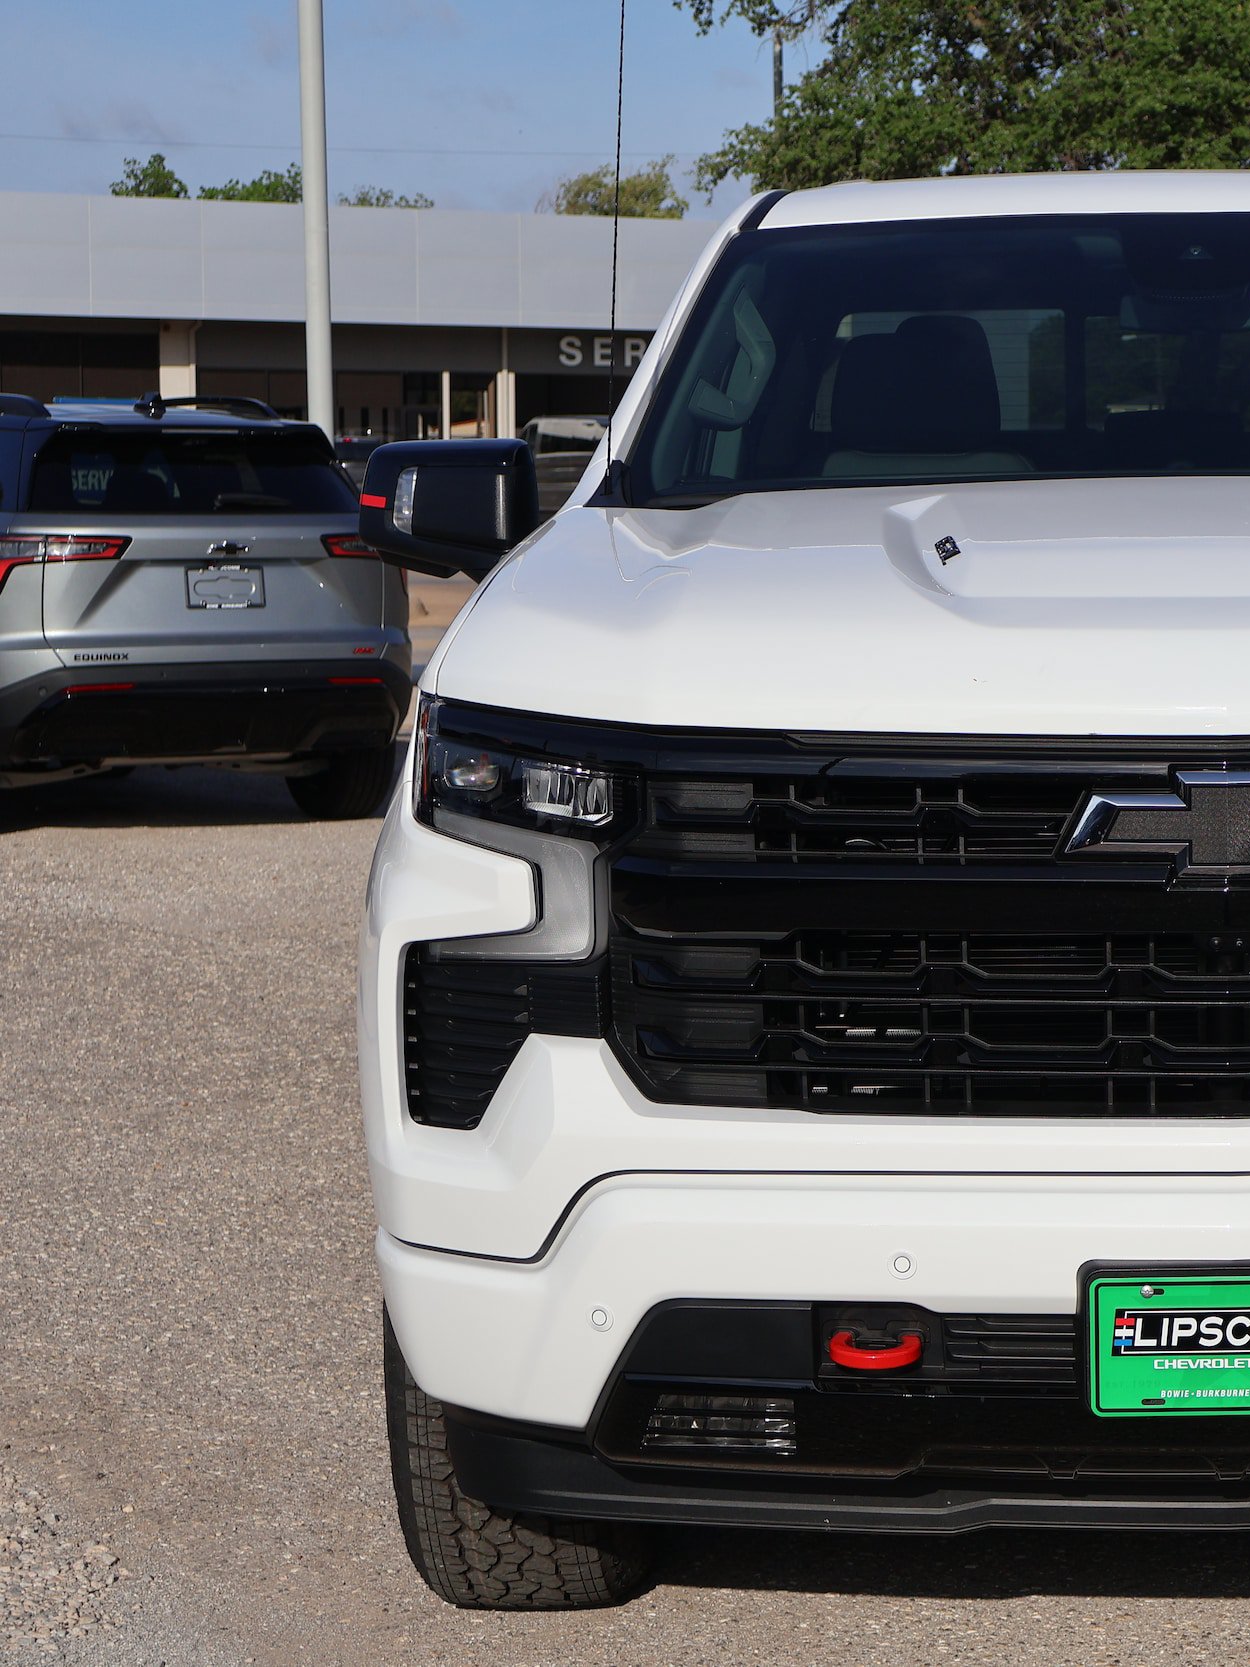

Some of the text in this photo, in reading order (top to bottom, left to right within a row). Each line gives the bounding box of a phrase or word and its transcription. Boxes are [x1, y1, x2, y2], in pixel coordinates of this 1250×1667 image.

[71, 468, 114, 491] SERV
[74, 652, 129, 662] EQUINOX
[1160, 1389, 1190, 1398] BOWIE
